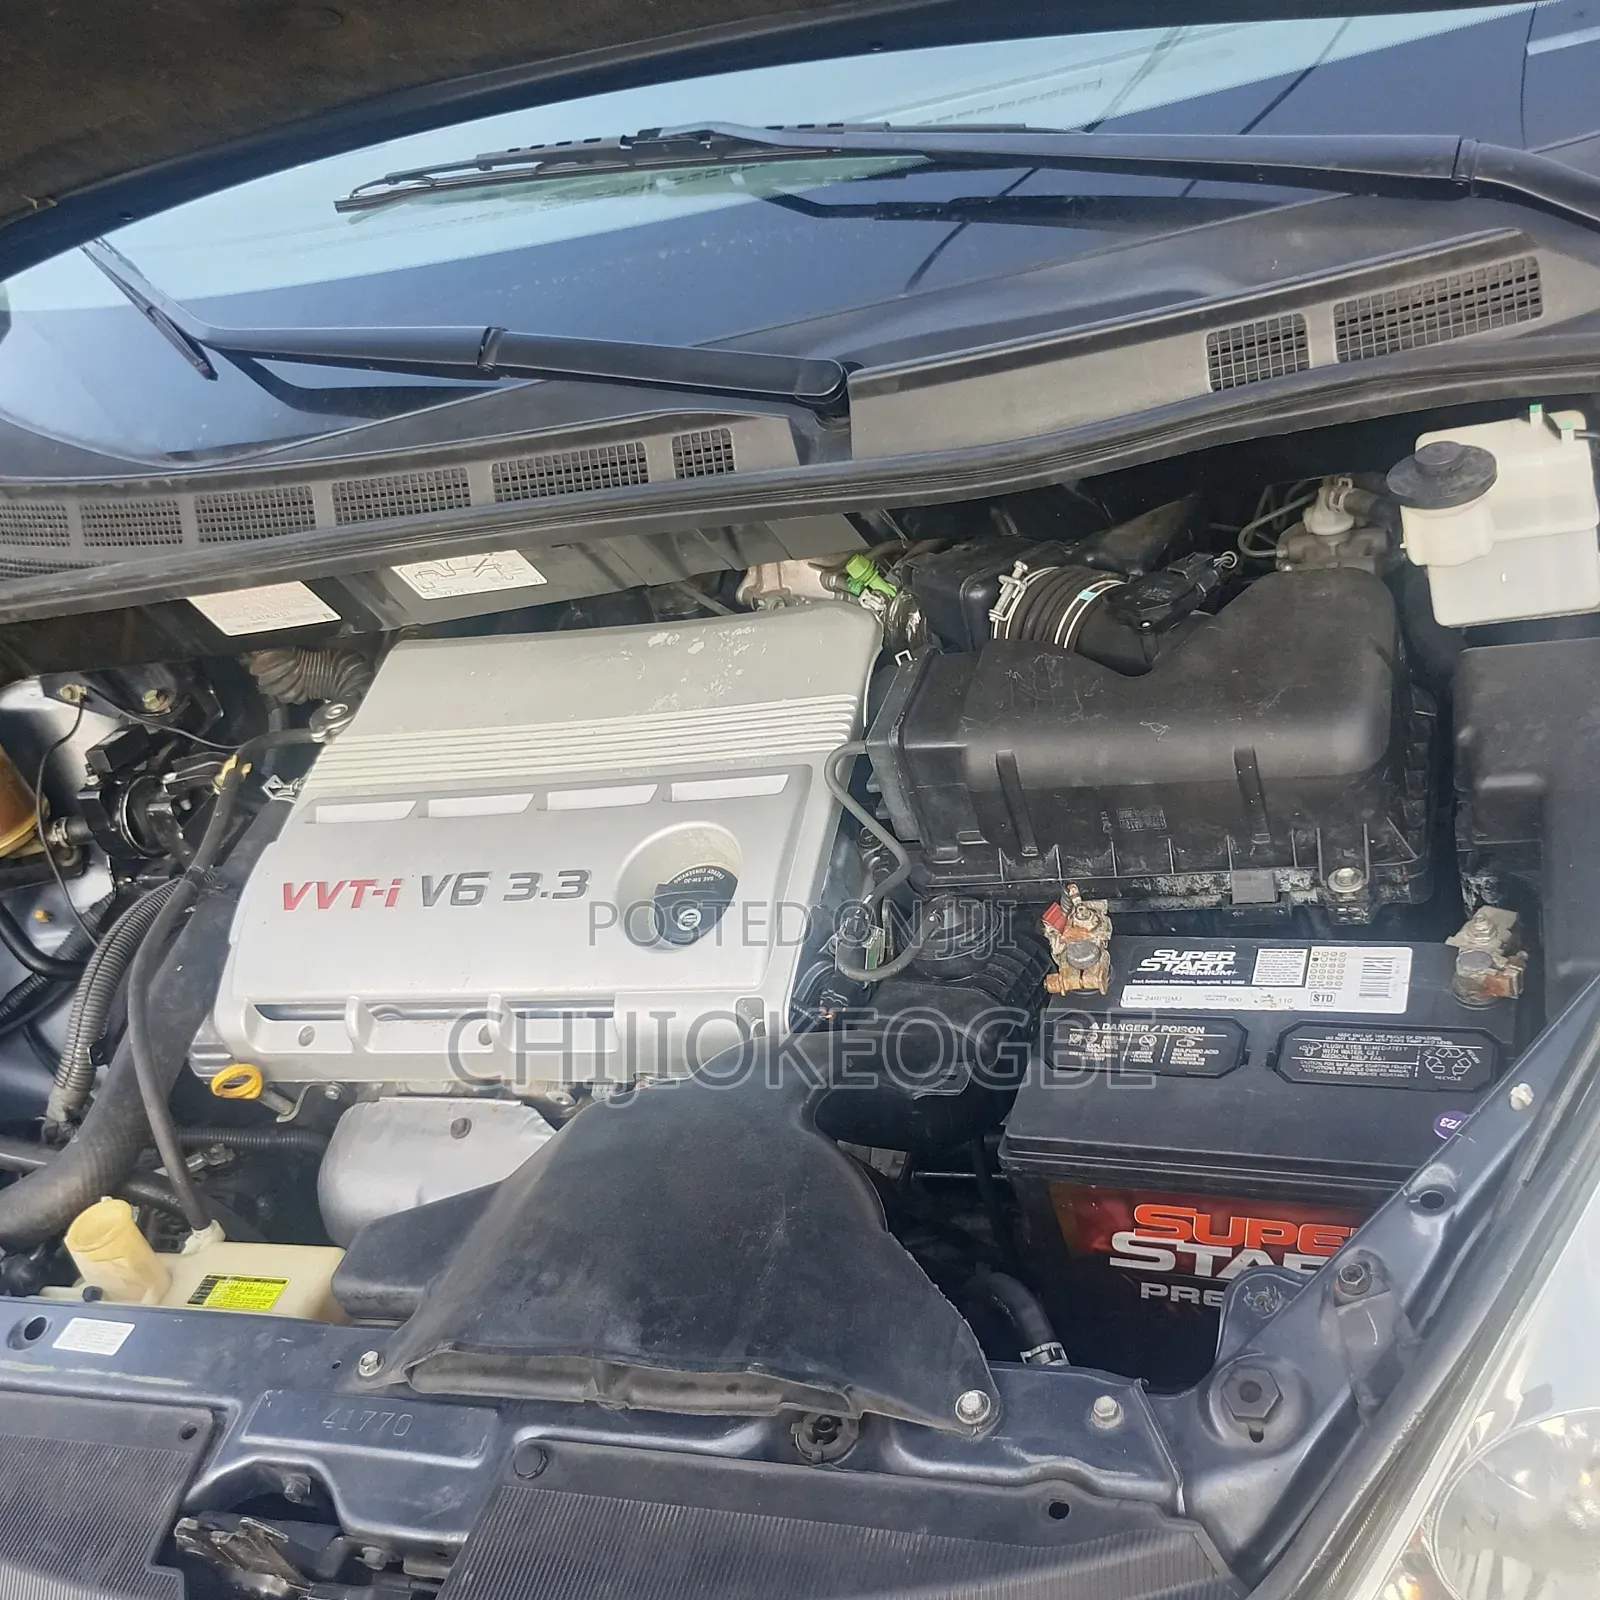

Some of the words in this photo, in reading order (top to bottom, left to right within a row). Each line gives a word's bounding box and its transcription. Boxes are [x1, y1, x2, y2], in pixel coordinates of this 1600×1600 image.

[282, 878, 404, 911] VVT-i
[421, 871, 493, 907] V6
[502, 869, 592, 902] 3.3
[1152, 949, 1237, 961] SUPER
[1137, 959, 1235, 972] START
[1313, 994, 1333, 1002] STD
[1101, 1023, 1149, 1032] DANGER
[1160, 1026, 1206, 1034] POISON
[1134, 1203, 1358, 1256] SUPE
[322, 1408, 414, 1436] 41770
